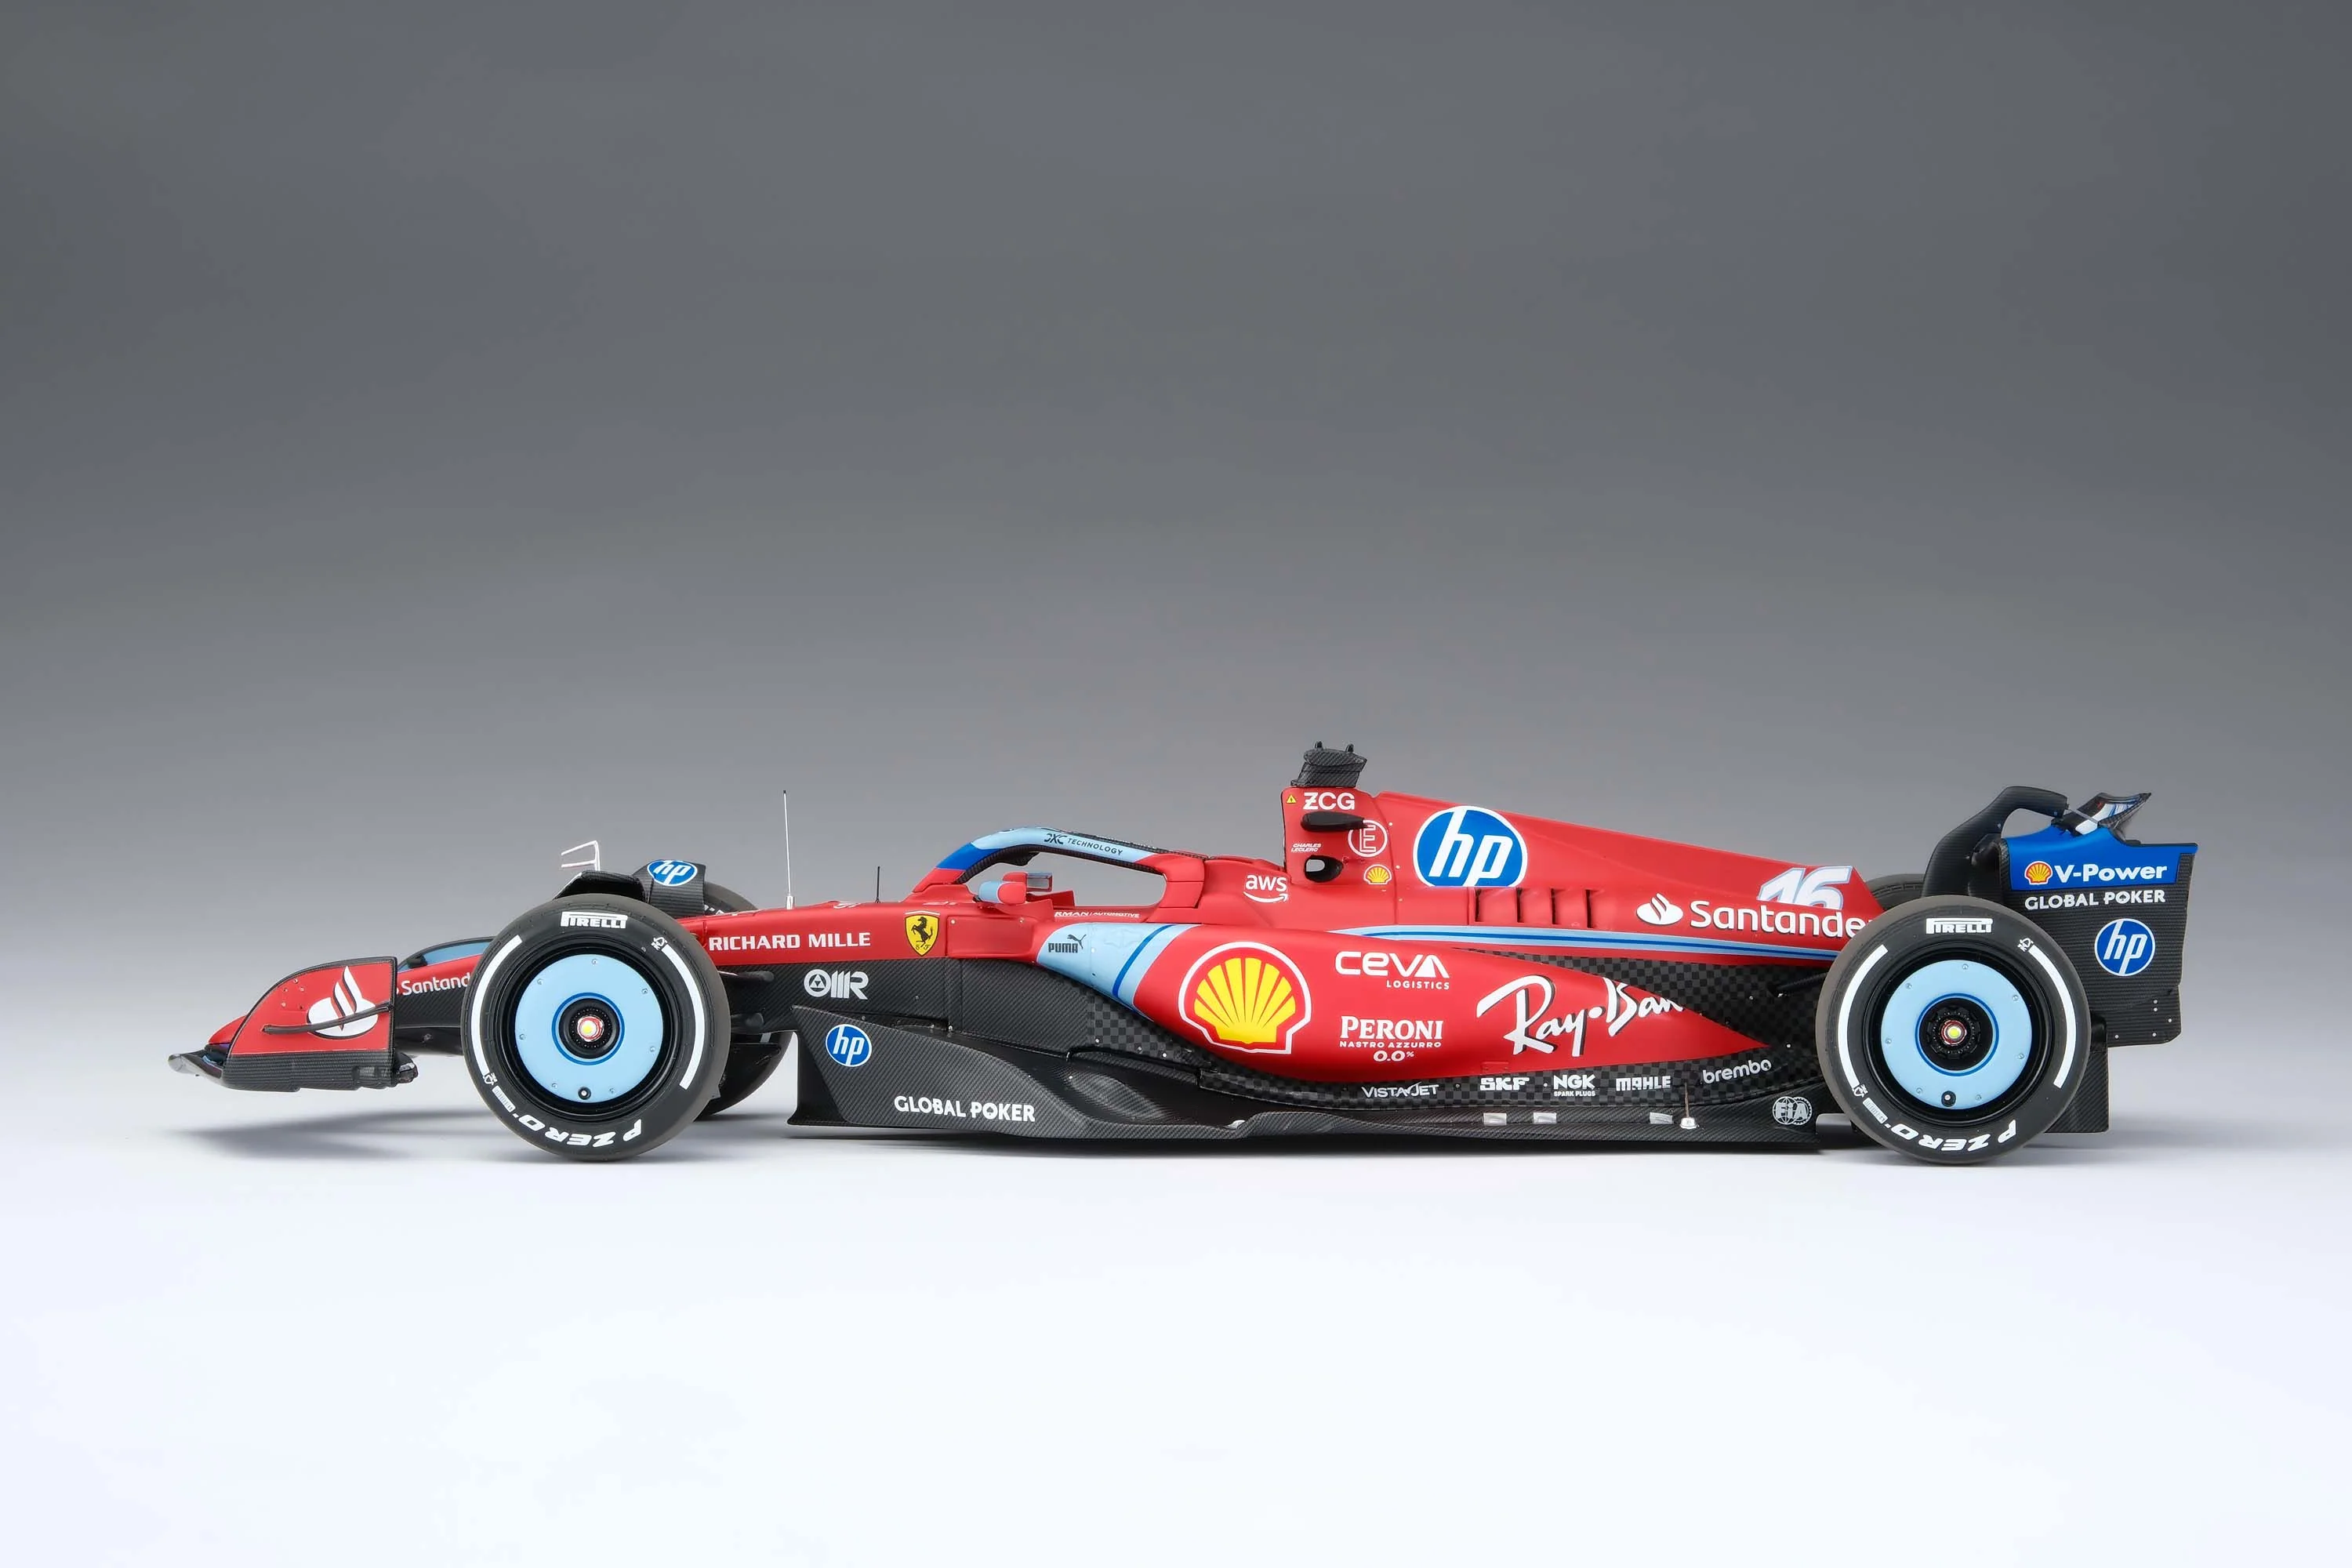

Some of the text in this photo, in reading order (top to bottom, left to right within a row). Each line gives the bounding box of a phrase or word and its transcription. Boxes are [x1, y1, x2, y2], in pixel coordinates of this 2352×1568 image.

[1303, 792, 1355, 810] ZCG
[1067, 837, 1123, 855] TECHNOLOGY
[1428, 808, 1514, 887] hp
[653, 861, 691, 886] hp
[1245, 874, 1287, 892] aws
[2054, 863, 2168, 883] V-Power
[2024, 889, 2166, 910] GLOBAL POKER
[561, 911, 629, 929] PIRELLI
[1690, 900, 1873, 938] Santande
[1926, 917, 1994, 935] PIRELLI
[709, 932, 871, 951] RICHARD MILLE
[1048, 942, 1079, 953] PUMA
[2103, 920, 2148, 975] hp
[401, 972, 470, 996] Santand
[1386, 980, 1450, 990] LOGISTICS
[1340, 1015, 1444, 1040] PERONI
[833, 1025, 866, 1066] hp
[1374, 1050, 1414, 1062] 0.0%
[1703, 1059, 1772, 1084] brembo
[1479, 1076, 1530, 1091] SKF
[1553, 1074, 1596, 1090] NGK
[1616, 1076, 1671, 1091] MAHLE
[894, 1095, 1036, 1122] GLOBAL POKER
[518, 1114, 642, 1148] P ZERO
[1891, 1120, 2016, 1152] P ZERO
